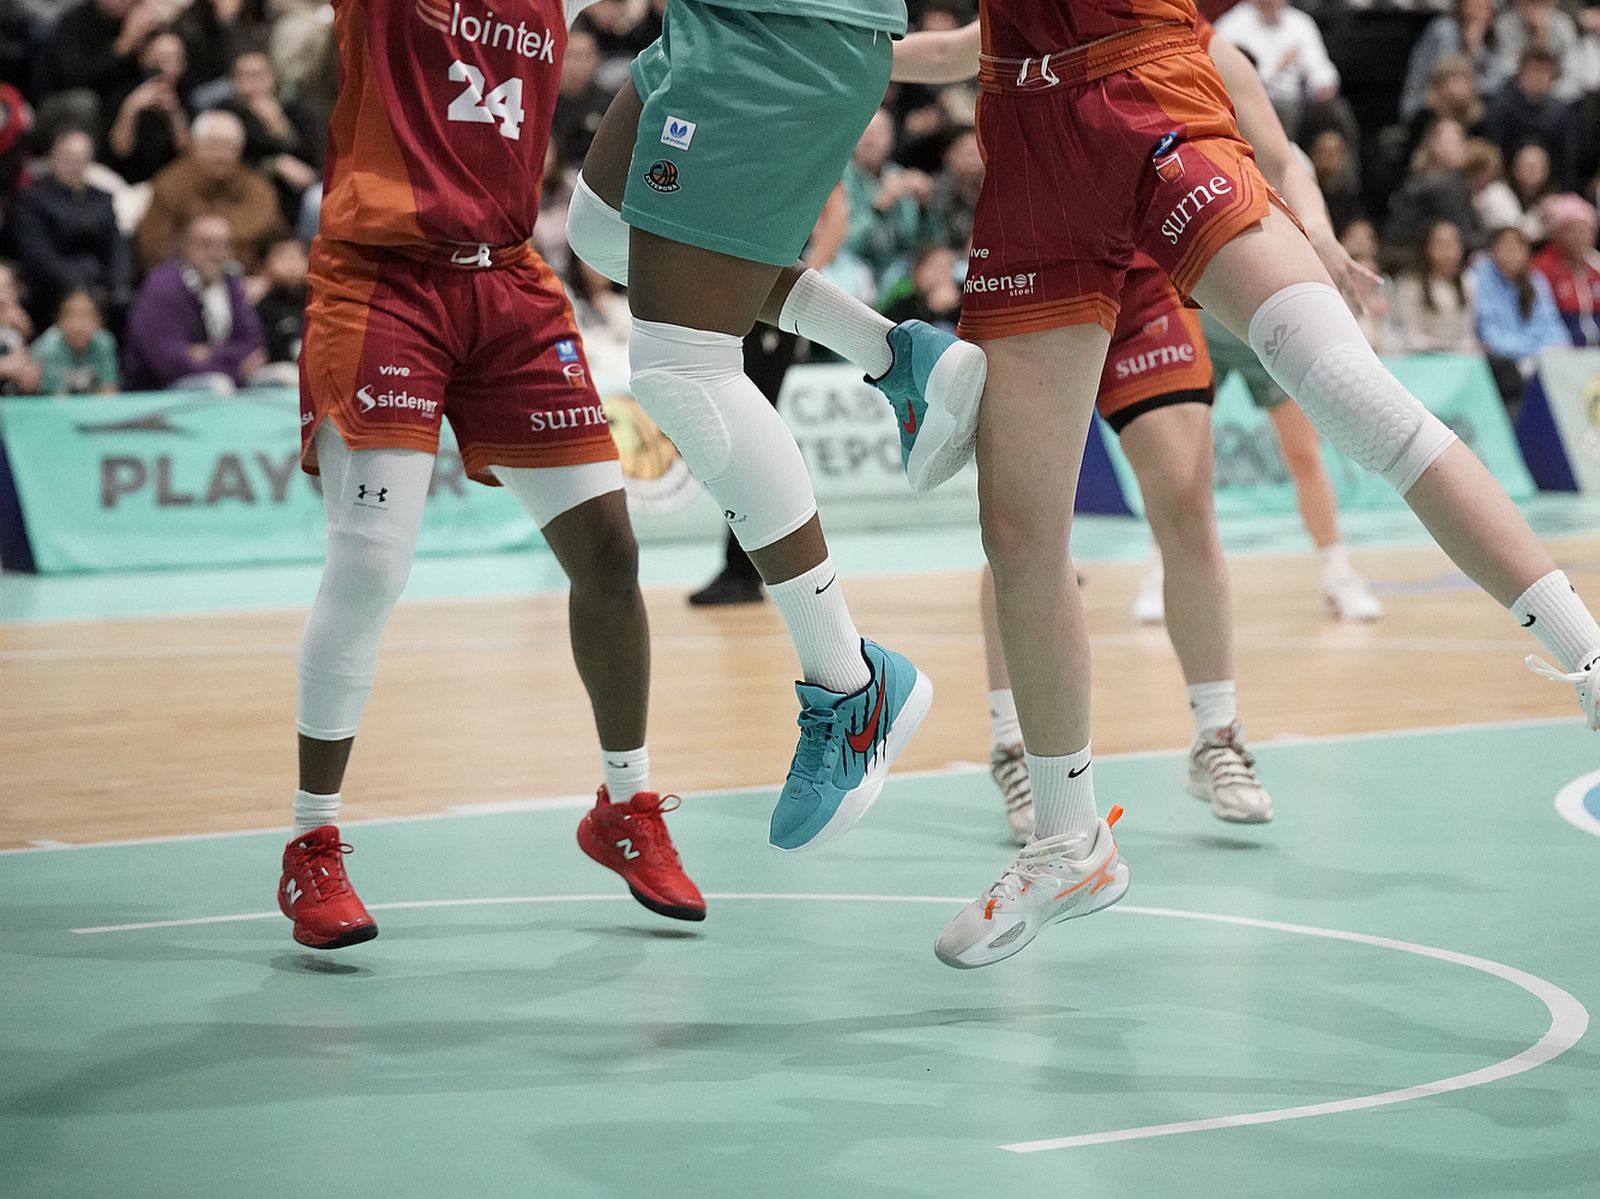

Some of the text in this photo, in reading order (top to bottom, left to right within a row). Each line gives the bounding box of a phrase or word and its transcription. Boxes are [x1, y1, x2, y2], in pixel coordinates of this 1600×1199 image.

[450, 2, 554, 64] lointek
[447, 59, 525, 141] 24
[1161, 174, 1233, 245] surne
[379, 364, 411, 377] vive
[1114, 342, 1195, 380] surne
[529, 403, 608, 432] surne
